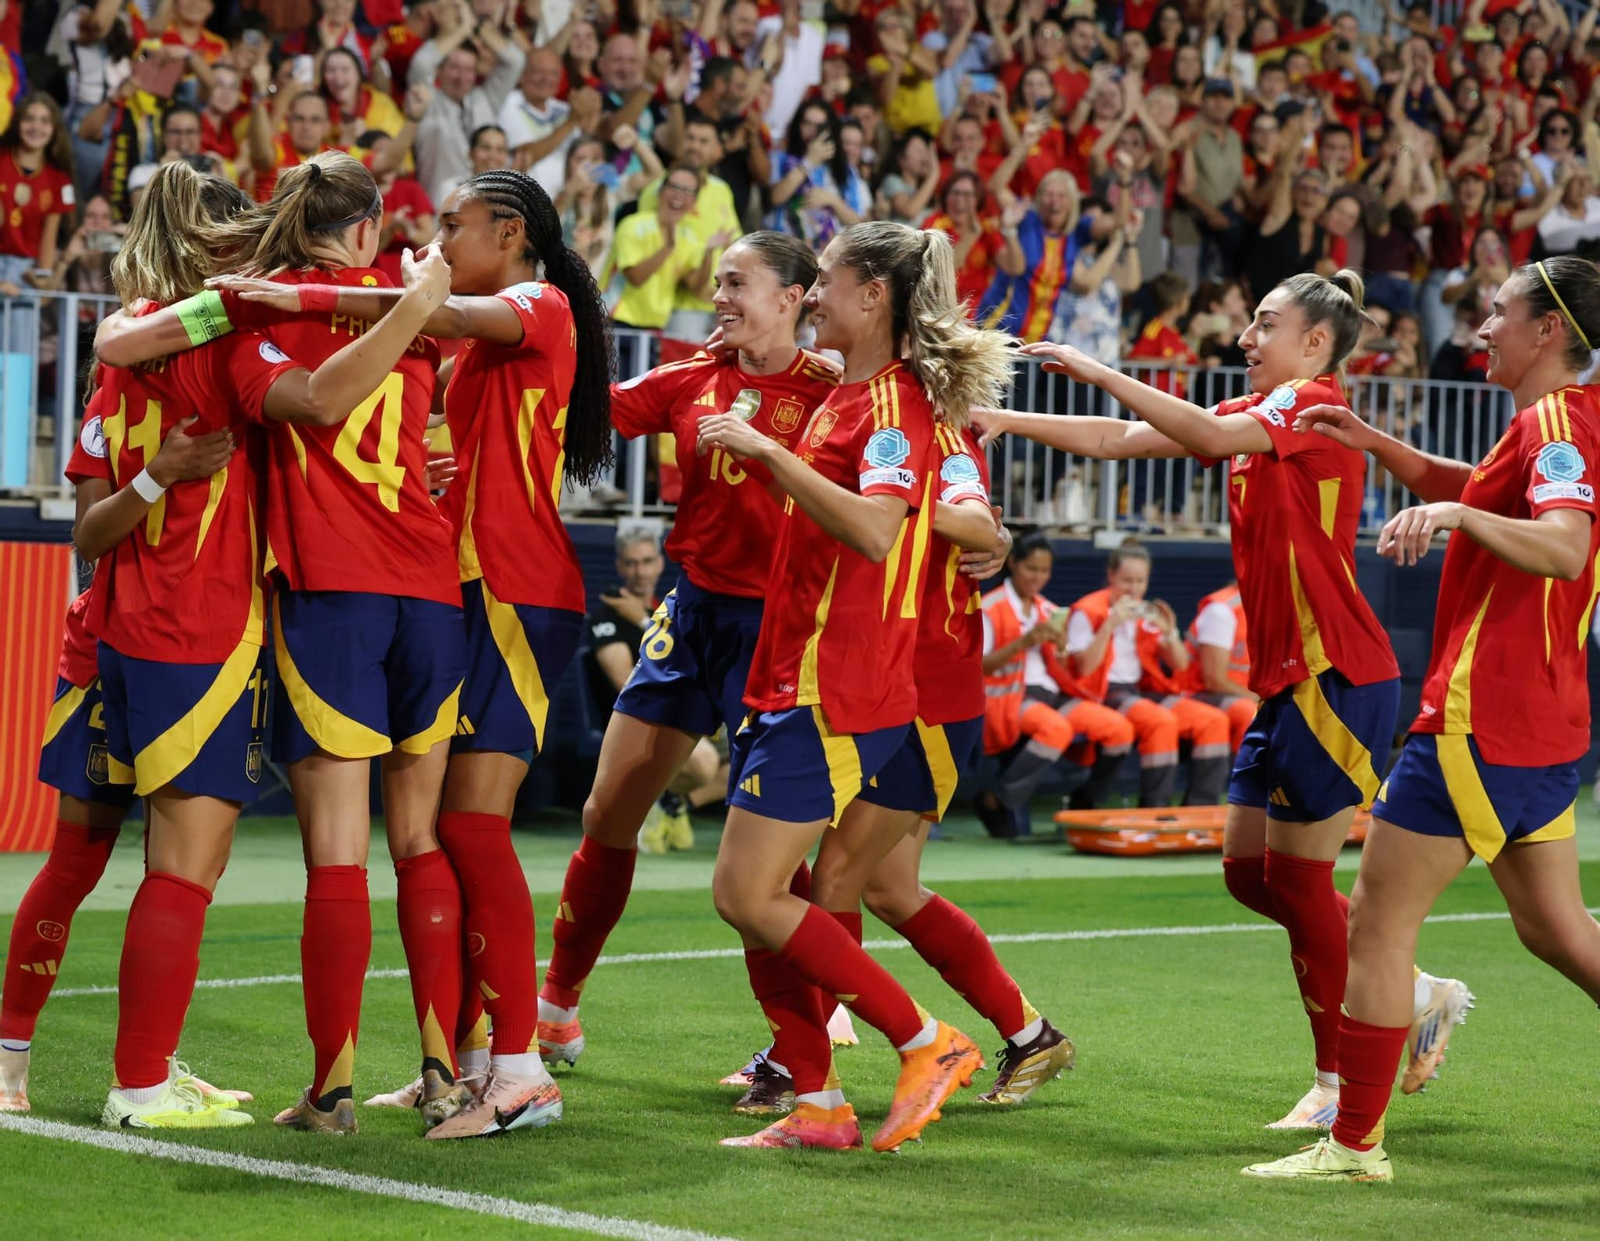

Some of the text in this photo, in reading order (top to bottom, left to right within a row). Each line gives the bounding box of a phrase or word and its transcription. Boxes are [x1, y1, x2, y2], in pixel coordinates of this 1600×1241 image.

[333, 371, 406, 513] 4
[102, 392, 166, 546] 11
[709, 448, 747, 485] 16
[897, 472, 911, 483] 10
[1576, 486, 1591, 497] 10
[248, 668, 269, 728] 11
